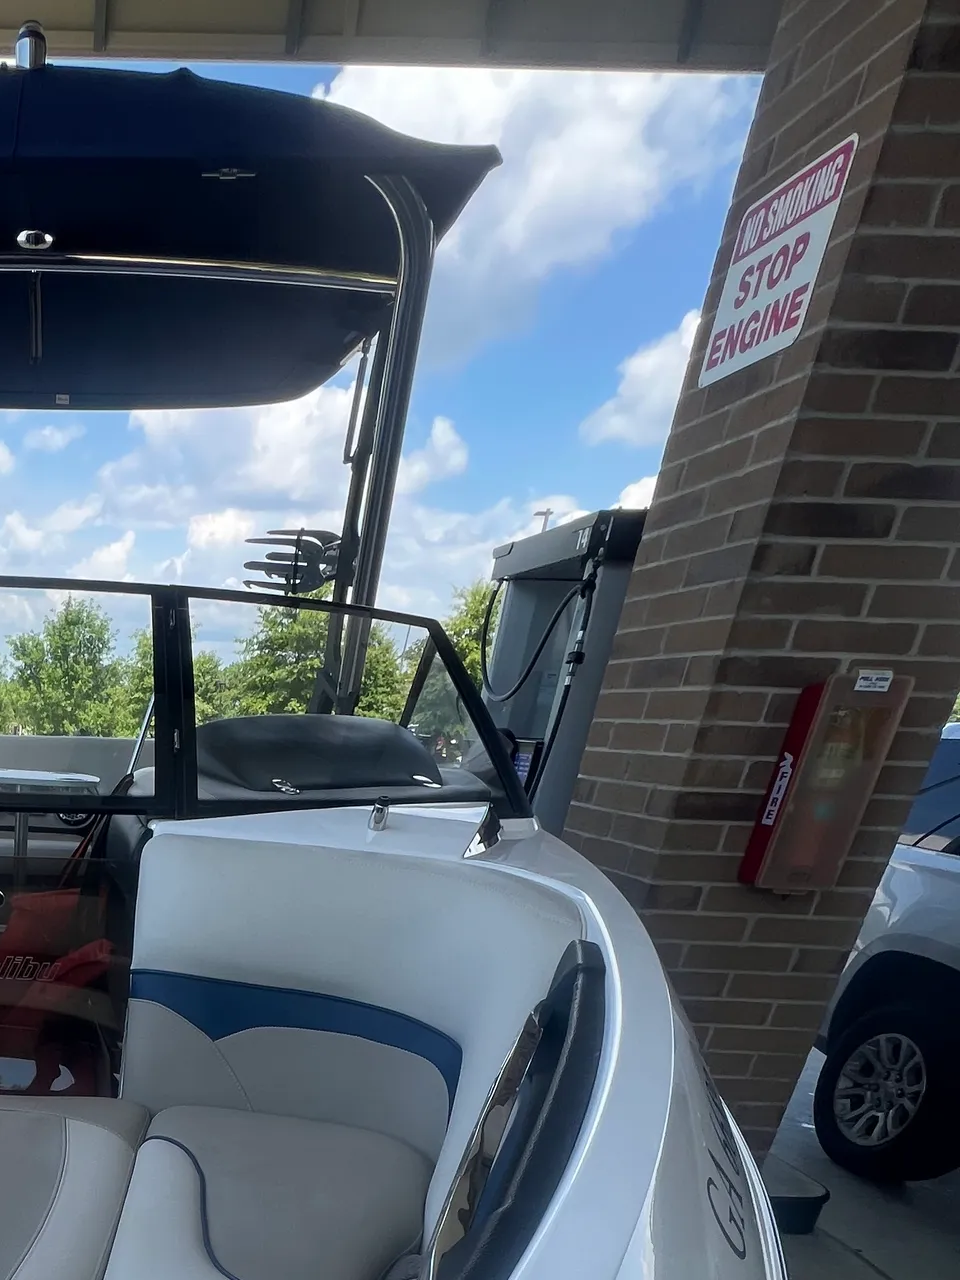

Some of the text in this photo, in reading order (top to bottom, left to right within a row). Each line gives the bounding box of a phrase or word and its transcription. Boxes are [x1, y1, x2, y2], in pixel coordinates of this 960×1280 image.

[739, 153, 845, 256] NO SMOKING
[734, 231, 811, 310] STOP
[705, 281, 810, 373] ENGINE
[765, 771, 789, 820] FIRE
